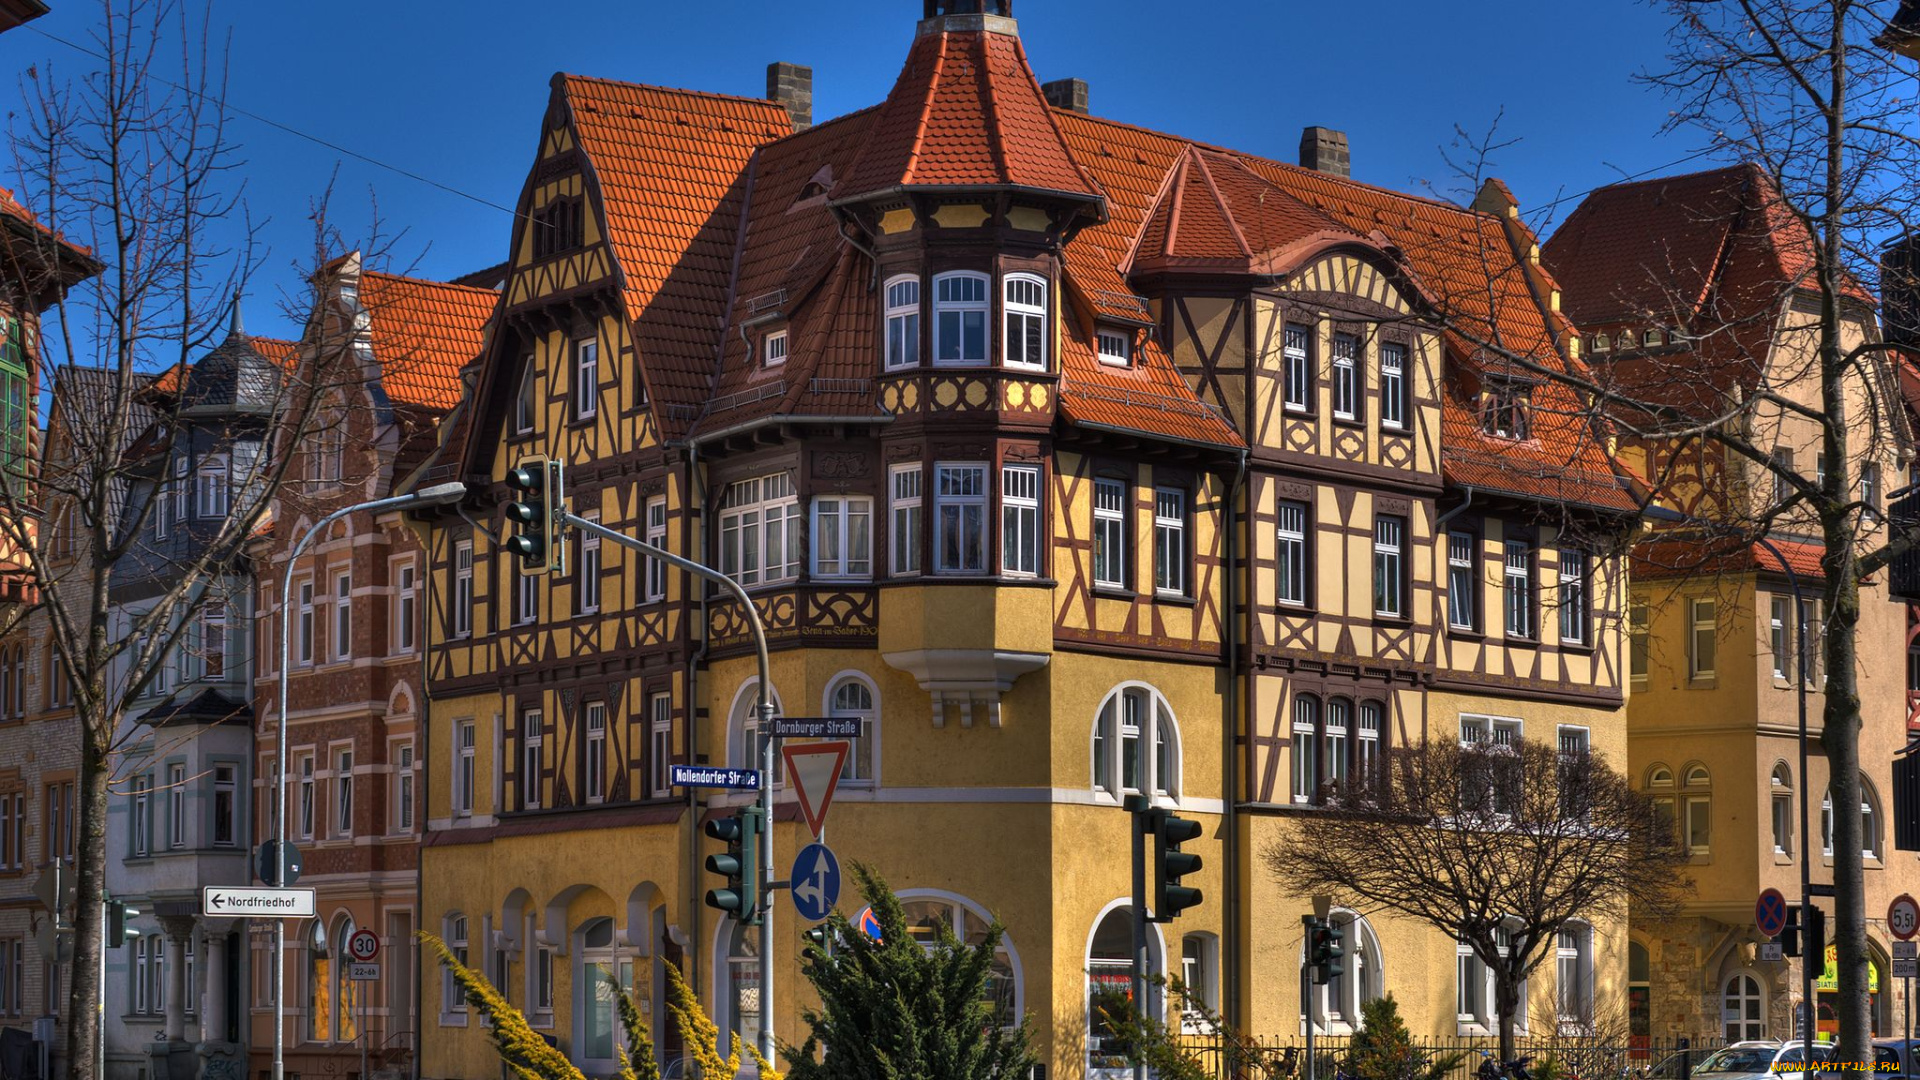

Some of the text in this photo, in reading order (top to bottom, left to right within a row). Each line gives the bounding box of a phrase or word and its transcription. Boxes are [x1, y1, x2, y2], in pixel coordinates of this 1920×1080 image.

[776, 722, 856, 736] Dornburger Straße
[676, 768, 756, 786] Nollendorfer Straße
[227, 896, 296, 907] Nordfriedhof
[355, 938, 374, 953] 30
[1894, 964, 1908, 973] 200
